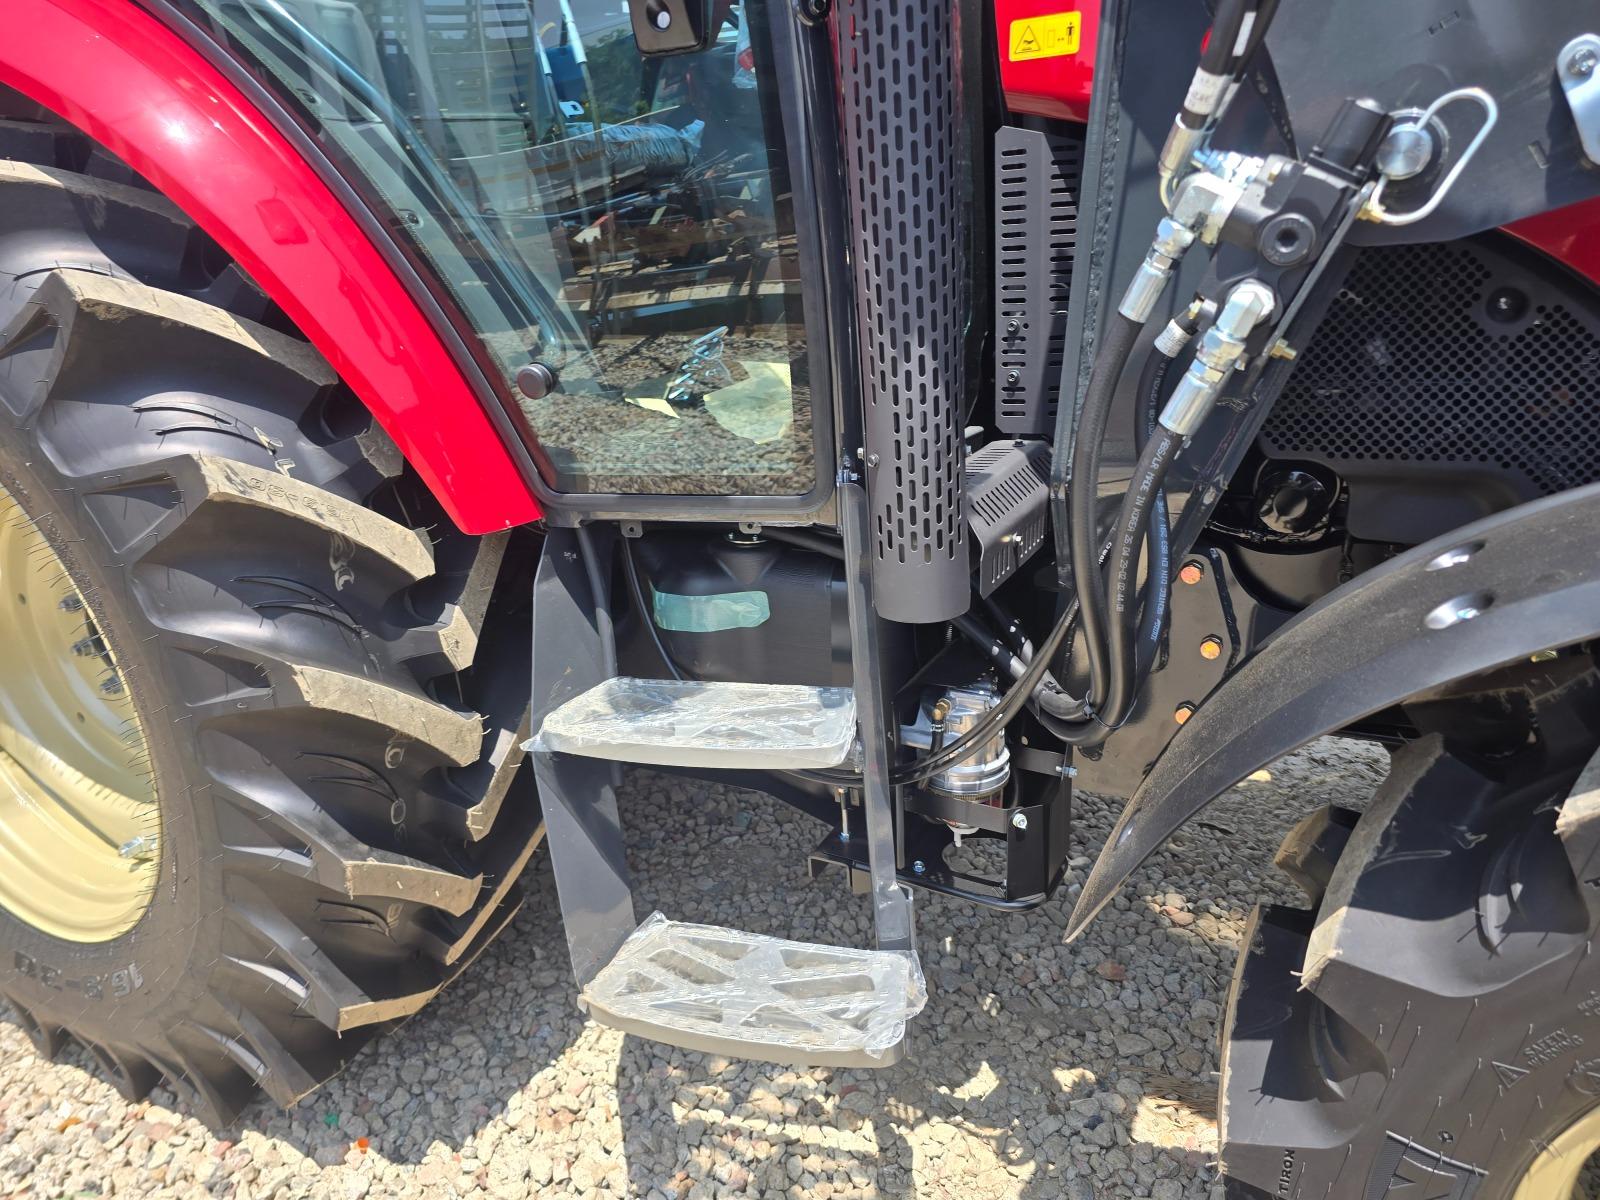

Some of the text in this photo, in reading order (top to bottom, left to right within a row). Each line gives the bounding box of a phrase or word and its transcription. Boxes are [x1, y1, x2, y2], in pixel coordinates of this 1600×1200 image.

[1140, 472, 1156, 492] MADE
[1136, 496, 1146, 506] IN
[1127, 508, 1141, 532] KOREA
[1524, 1028, 1569, 1057] SAFETY
[1527, 1035, 1584, 1065] WARNING
